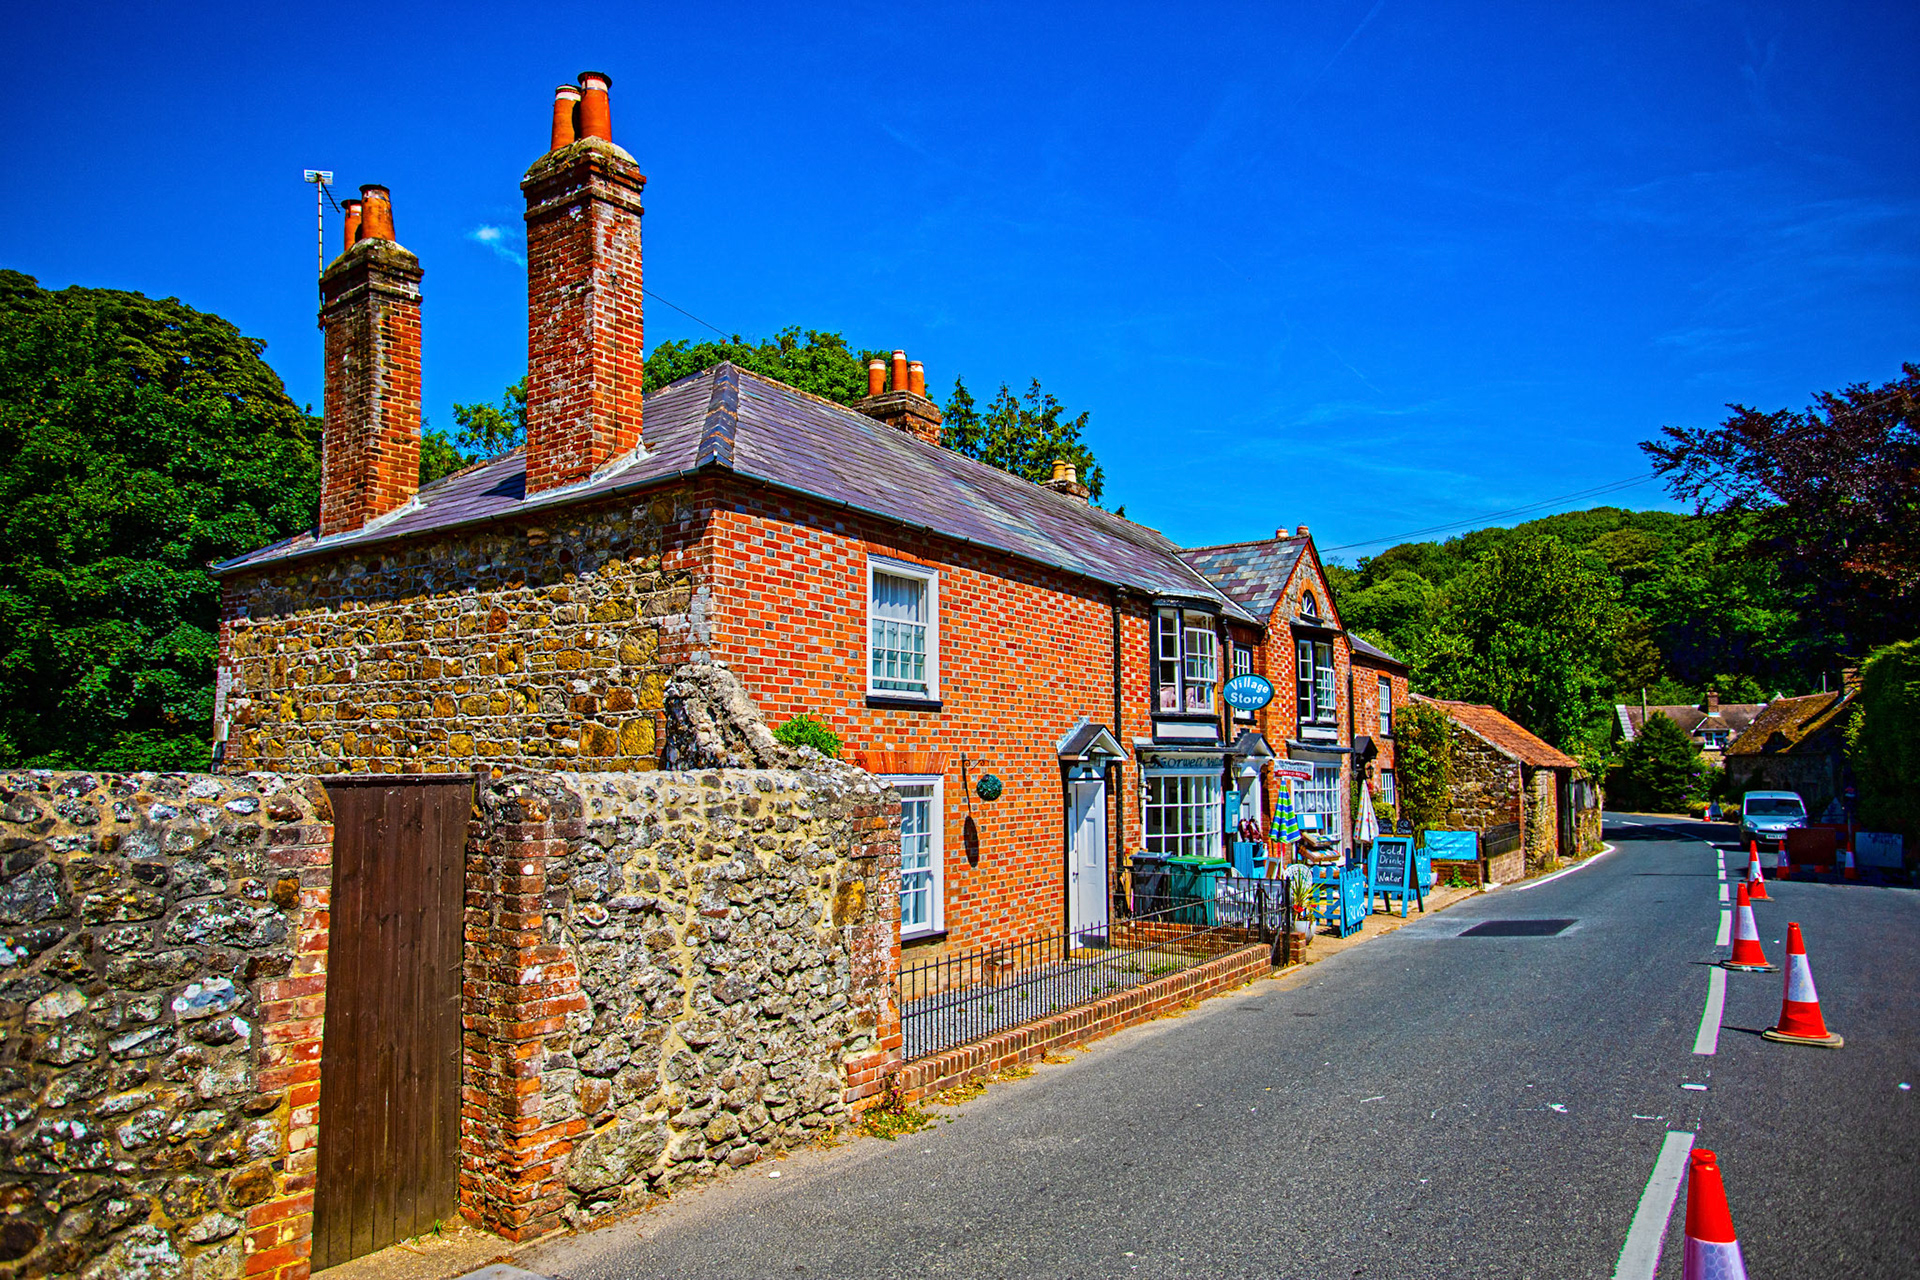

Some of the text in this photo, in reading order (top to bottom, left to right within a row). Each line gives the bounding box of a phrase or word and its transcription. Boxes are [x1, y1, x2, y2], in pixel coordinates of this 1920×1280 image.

[1229, 677, 1269, 694] Village
[1230, 692, 1264, 704] Store
[1379, 844, 1404, 856] Cold
[1376, 871, 1402, 882] Water
